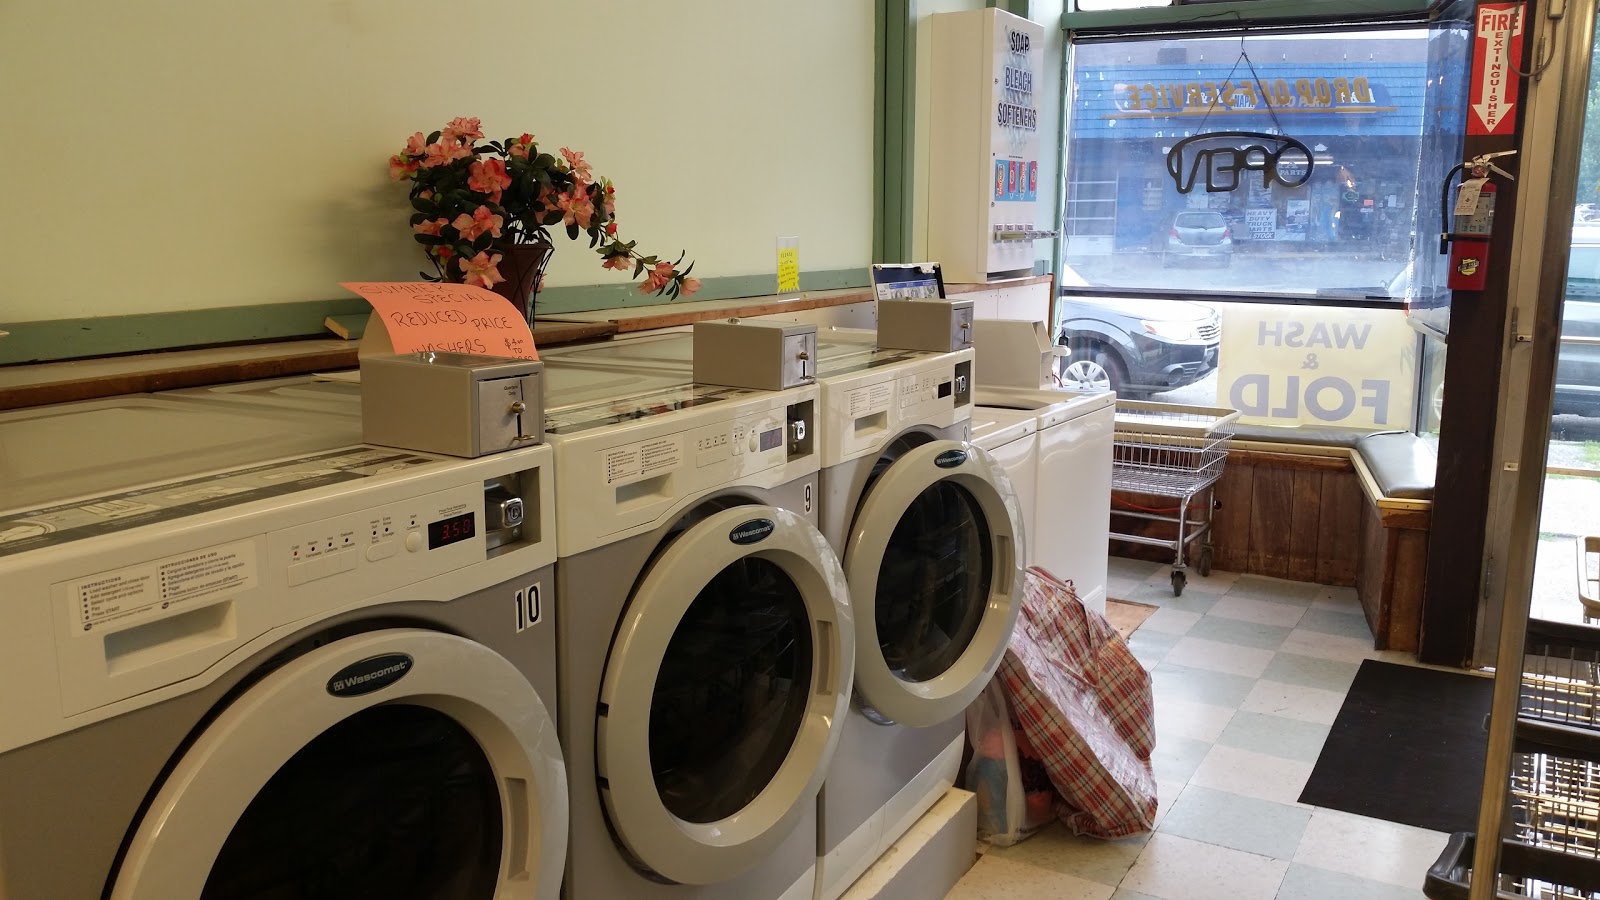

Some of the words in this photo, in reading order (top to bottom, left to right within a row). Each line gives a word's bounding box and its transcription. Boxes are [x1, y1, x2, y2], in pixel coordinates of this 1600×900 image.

[1481, 14, 1519, 31] FIRE
[1010, 29, 1030, 53] SOAP
[1005, 66, 1032, 94] BLEACH
[1486, 32, 1504, 125] EXTINGUISHER
[997, 102, 1037, 132] SOFTENERS
[359, 283, 454, 295] SUMMER
[412, 293, 493, 305] SPECIAL
[390, 309, 468, 329] REDUCED
[470, 316, 513, 332] PRICE
[805, 485, 811, 512] 9
[81, 576, 121, 590] INSTRUCTIONS
[515, 584, 540, 631] 10
[344, 661, 407, 688] Wascomat
